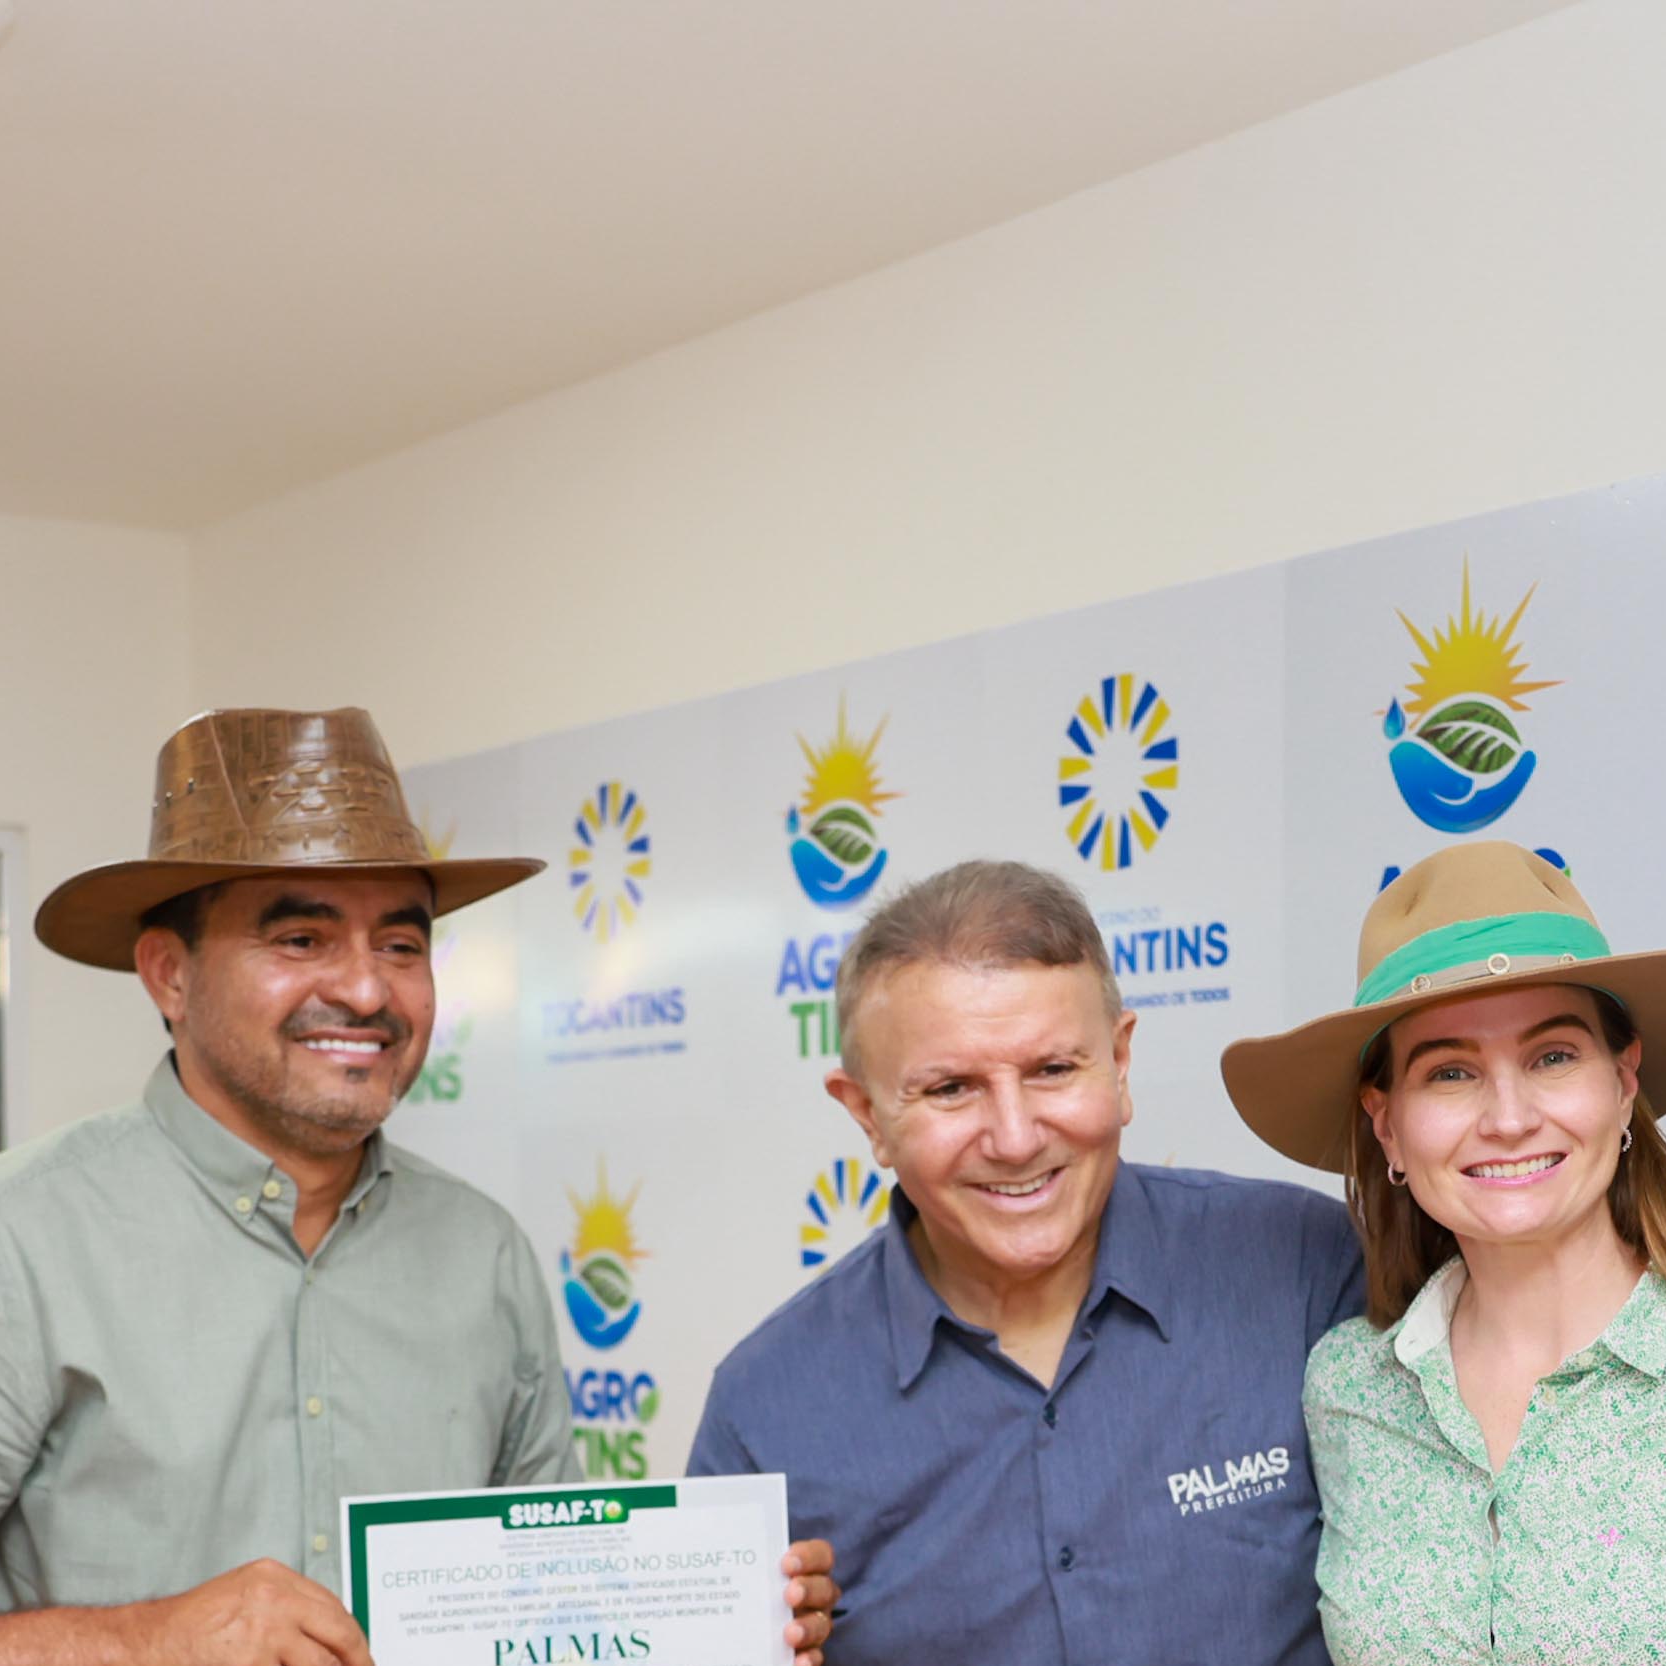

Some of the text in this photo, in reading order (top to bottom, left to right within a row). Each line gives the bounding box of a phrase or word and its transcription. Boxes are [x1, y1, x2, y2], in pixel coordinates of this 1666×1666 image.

[776, 932, 851, 996] AG
[1114, 921, 1229, 976] NTINS
[789, 1000, 842, 1059] TI
[1167, 1447, 1290, 1504] PALMAS
[1179, 1479, 1287, 1516] PREFEITURA
[508, 1499, 623, 1527] SUSAF-TO
[382, 1549, 757, 1589] CERTIFICADO DE INCLUSÃO NO SUSAF-TO
